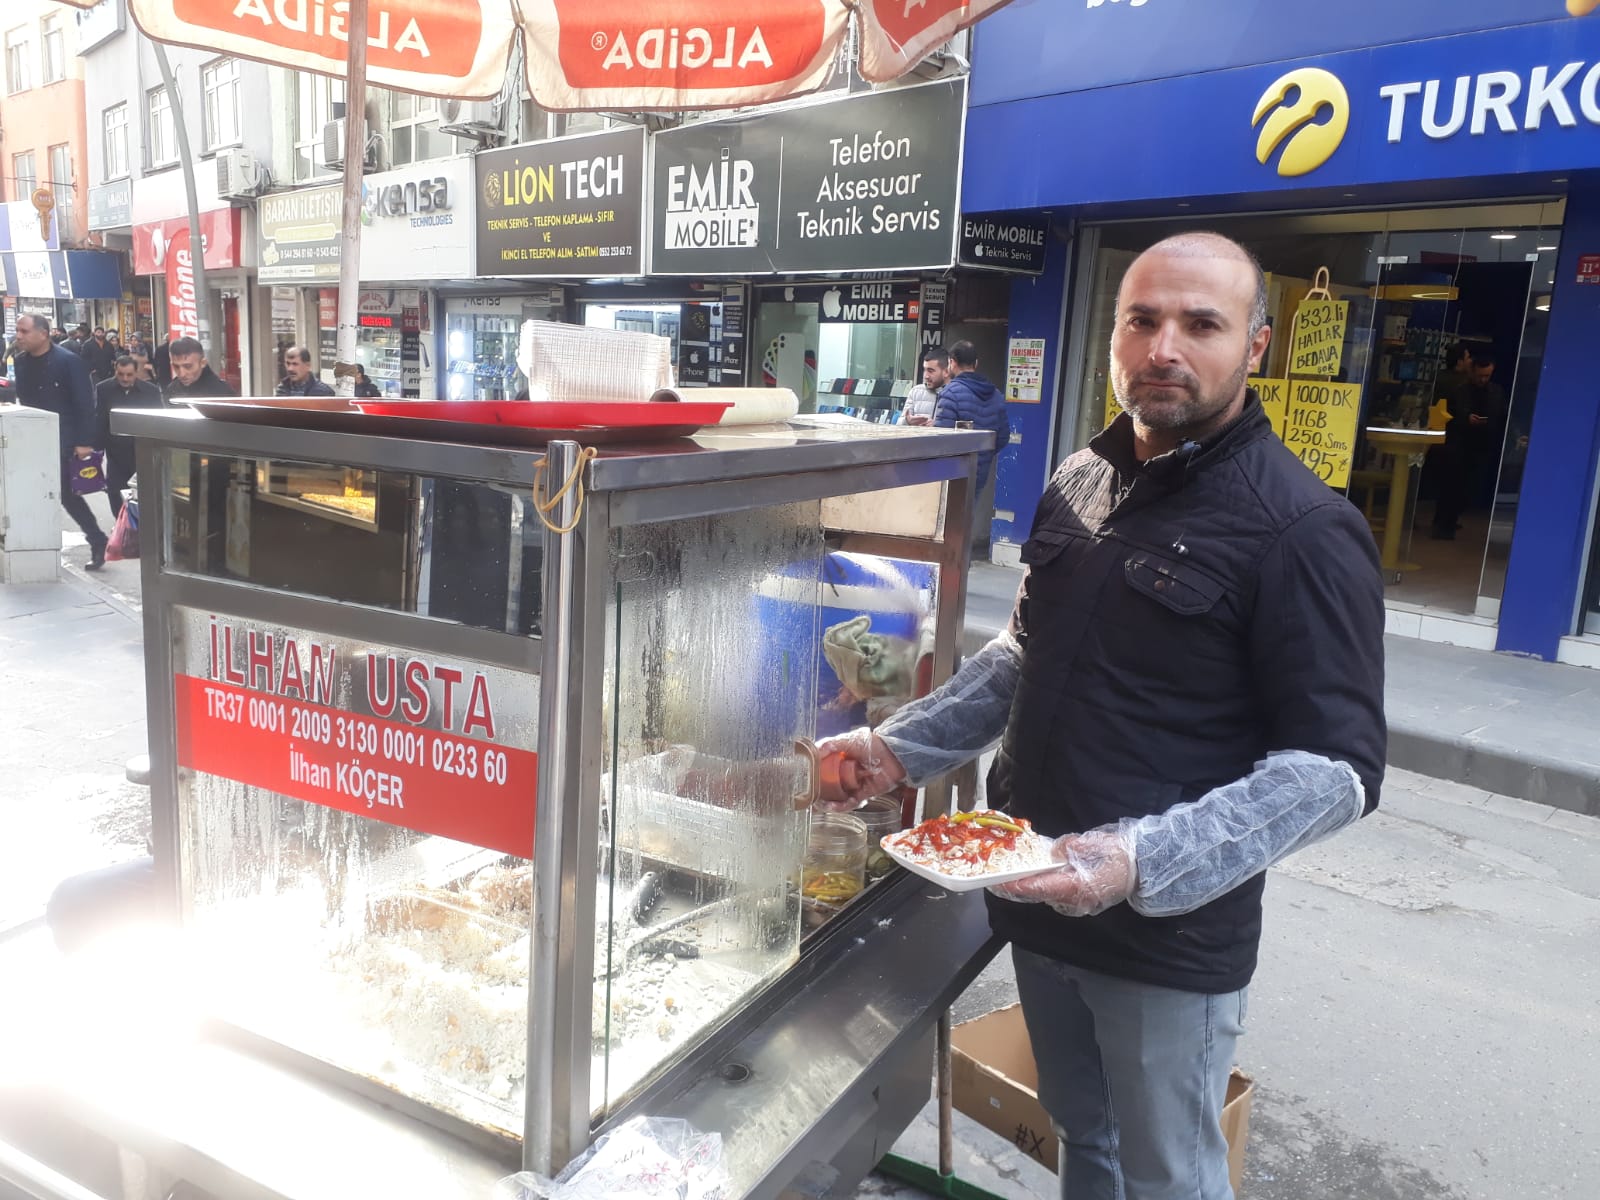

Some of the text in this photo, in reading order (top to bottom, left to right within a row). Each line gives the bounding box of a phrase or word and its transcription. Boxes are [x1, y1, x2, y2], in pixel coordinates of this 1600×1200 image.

[829, 130, 911, 166] Telefon
[503, 154, 623, 206] LİON TECH
[667, 147, 757, 213] EMİR
[816, 172, 922, 203] Aksesuar
[265, 198, 298, 224] BARAN
[533, 214, 561, 227] TELEFON
[562, 212, 594, 225] KAPLAMA
[797, 200, 940, 239] Teknik Servis
[542, 231, 551, 242] VE
[674, 212, 747, 248] MOBİLE
[965, 219, 1044, 246] EMİR MOBİLE
[520, 248, 528, 259] EL
[529, 247, 556, 259] TELEFON
[557, 248, 573, 258] ALIM
[985, 245, 1032, 261] Teknik Servis
[170, 249, 198, 341] dafone
[843, 299, 904, 321] MOBİLE
[1298, 325, 1342, 350] HATLAR
[1296, 345, 1338, 369] BEDAVA
[1262, 385, 1281, 402] DK
[1297, 385, 1352, 409] 1000 DK
[210, 615, 496, 740] İLHAN USTA
[204, 687, 507, 786] TR37 0001 2009 3130 0001 0233 60
[289, 743, 404, 809] İlhan KÖÇER
